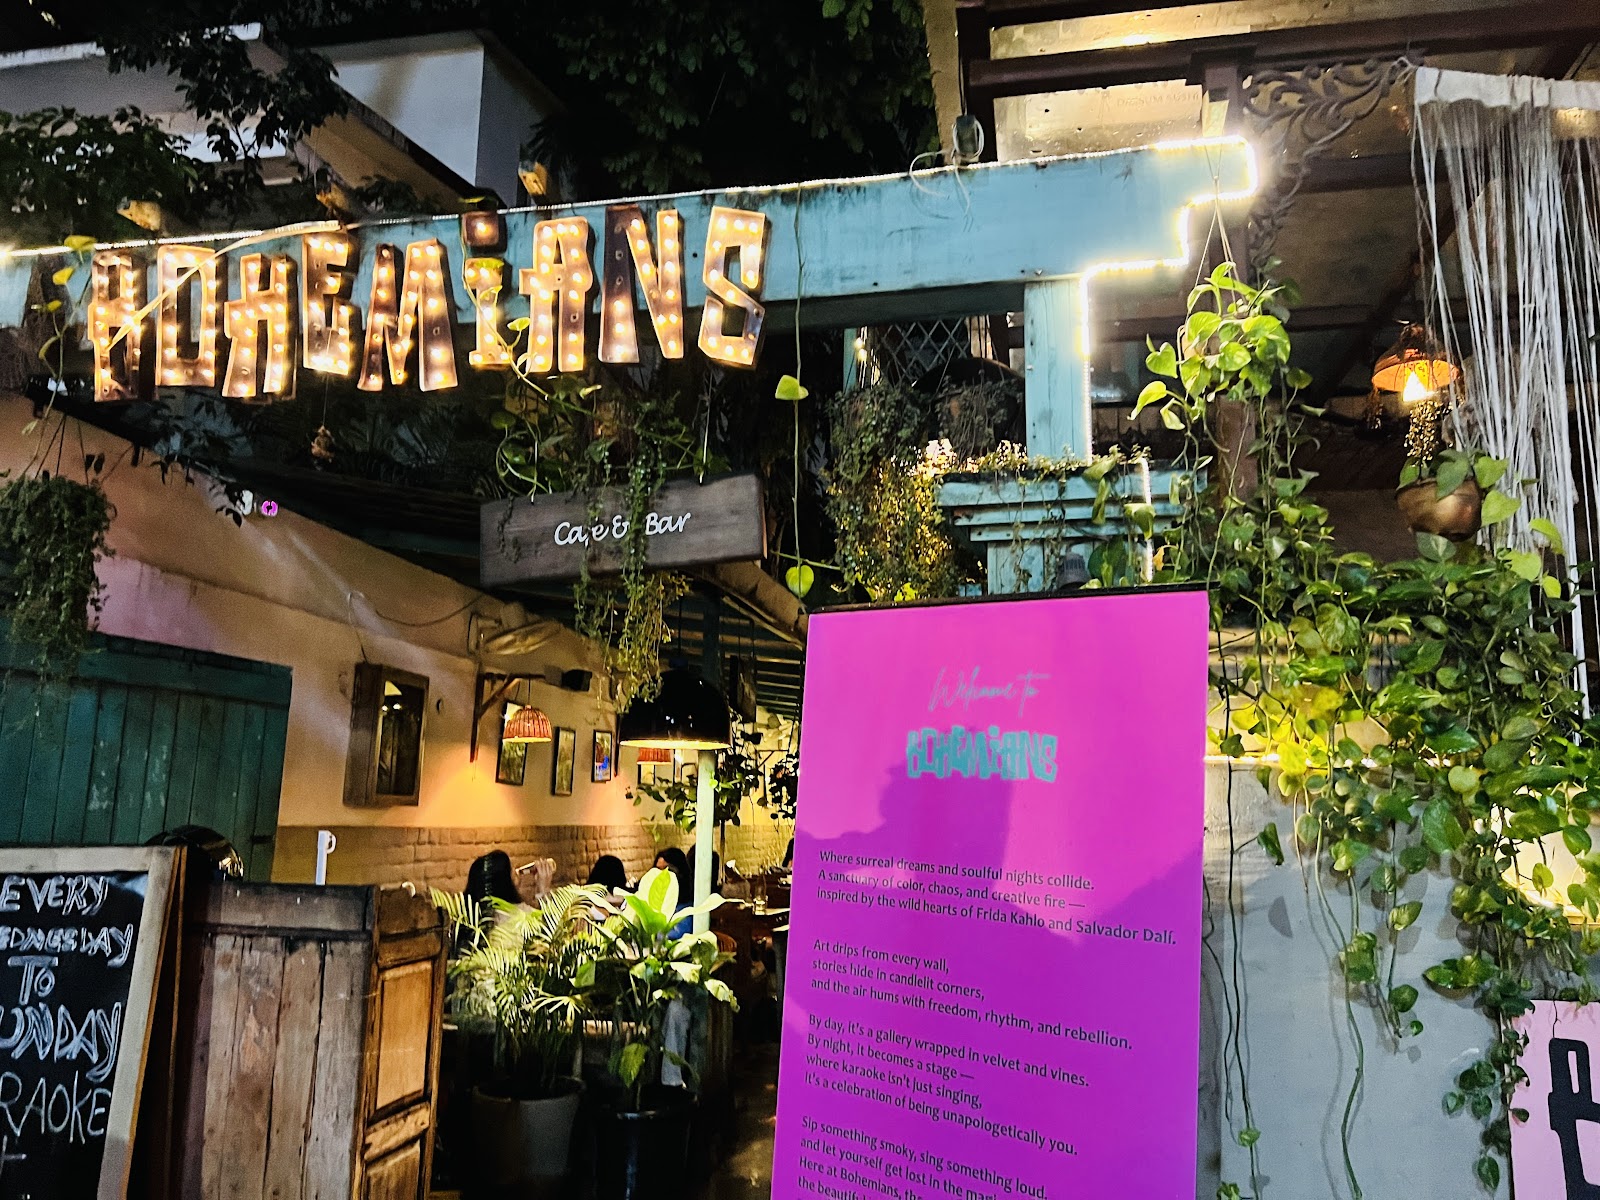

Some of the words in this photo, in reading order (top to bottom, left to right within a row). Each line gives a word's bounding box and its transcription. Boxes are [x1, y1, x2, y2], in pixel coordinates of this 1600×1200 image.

[612, 514, 630, 539] &
[645, 512, 691, 536] Bar
[818, 869, 826, 880] A
[828, 871, 879, 888] sanctuary
[882, 876, 895, 888] of
[897, 879, 926, 893] color,
[928, 881, 963, 898] chaos,
[966, 887, 988, 900] and
[991, 891, 1040, 906] creative
[1044, 893, 1066, 909] fire
[819, 851, 853, 864] Where
[856, 856, 894, 868] surreal
[896, 858, 935, 873] dreams
[938, 864, 958, 876] and
[961, 866, 1002, 880] soulful
[1006, 869, 1044, 886] nights
[1047, 874, 1095, 890] collide.
[0, 874, 109, 916] EVERY
[817, 887, 858, 903] inspired
[861, 891, 875, 908] by
[877, 894, 896, 908] the
[898, 898, 921, 911] wild
[923, 900, 957, 916] hearts
[960, 905, 974, 918] of
[976, 907, 1007, 923] Frida
[1010, 911, 1045, 928] Kahlo
[1048, 918, 1072, 931] and
[1076, 920, 1139, 940] Salvador
[812, 959, 847, 974] stories
[850, 963, 874, 979] hide
[876, 968, 887, 980] in
[889, 972, 934, 990] candlelit
[937, 981, 985, 1002] corners,
[813, 939, 830, 952] Art
[832, 942, 859, 958] drips
[862, 946, 889, 961] from
[891, 953, 921, 969] every
[923, 958, 949, 975] wall,
[811, 978, 830, 991] and
[833, 981, 850, 994] the
[852, 985, 867, 997] air
[870, 986, 900, 1004] hums
[902, 994, 925, 1009] with
[928, 998, 982, 1023] freedom,
[985, 1010, 1034, 1033] rhythm,
[1037, 1023, 1061, 1036] and
[1064, 1027, 1133, 1050] rebellion.
[807, 1033, 821, 1049] By
[823, 1037, 854, 1056] night,
[857, 1042, 865, 1056] it
[867, 1045, 914, 1068] becomes
[917, 1060, 923, 1070] a
[925, 1062, 958, 1080] stage
[809, 1013, 822, 1030] By
[824, 1017, 845, 1034] day,
[867, 1028, 873, 1038] a
[875, 1029, 912, 1049] gallery
[914, 1039, 965, 1059] wrapped
[968, 1047, 980, 1062] in
[983, 1053, 1020, 1071] velvet
[1023, 1063, 1047, 1077] and
[1050, 1067, 1089, 1087] vines.
[806, 1053, 839, 1071] where
[842, 1060, 886, 1082] karaoke
[888, 1071, 911, 1088] isn't
[912, 1078, 933, 1094] just
[936, 1084, 982, 1109] singing,
[0, 1070, 111, 1145] RAOKE
[822, 1079, 829, 1088] a
[831, 1079, 892, 1104] celebration
[894, 1095, 906, 1108] of
[908, 1097, 940, 1121] being
[942, 1109, 1046, 1149] unapologetically
[1049, 1138, 1078, 1156] you.
[799, 1156, 824, 1173] Here
[827, 1166, 838, 1178] at
[800, 1137, 820, 1151] and
[822, 1141, 836, 1156] let
[839, 1149, 884, 1171] yourself
[885, 1163, 903, 1178] get
[905, 1166, 926, 1185] lost
[929, 1174, 940, 1189] in
[943, 1180, 963, 1197] the
[802, 1115, 818, 1133] Sip
[820, 1123, 878, 1150] something
[879, 1138, 917, 1163] smoky,
[919, 1150, 944, 1172] sing
[946, 1160, 1012, 1193] something
[1015, 1178, 1048, 1200] loud.
[798, 1176, 815, 1192] the
